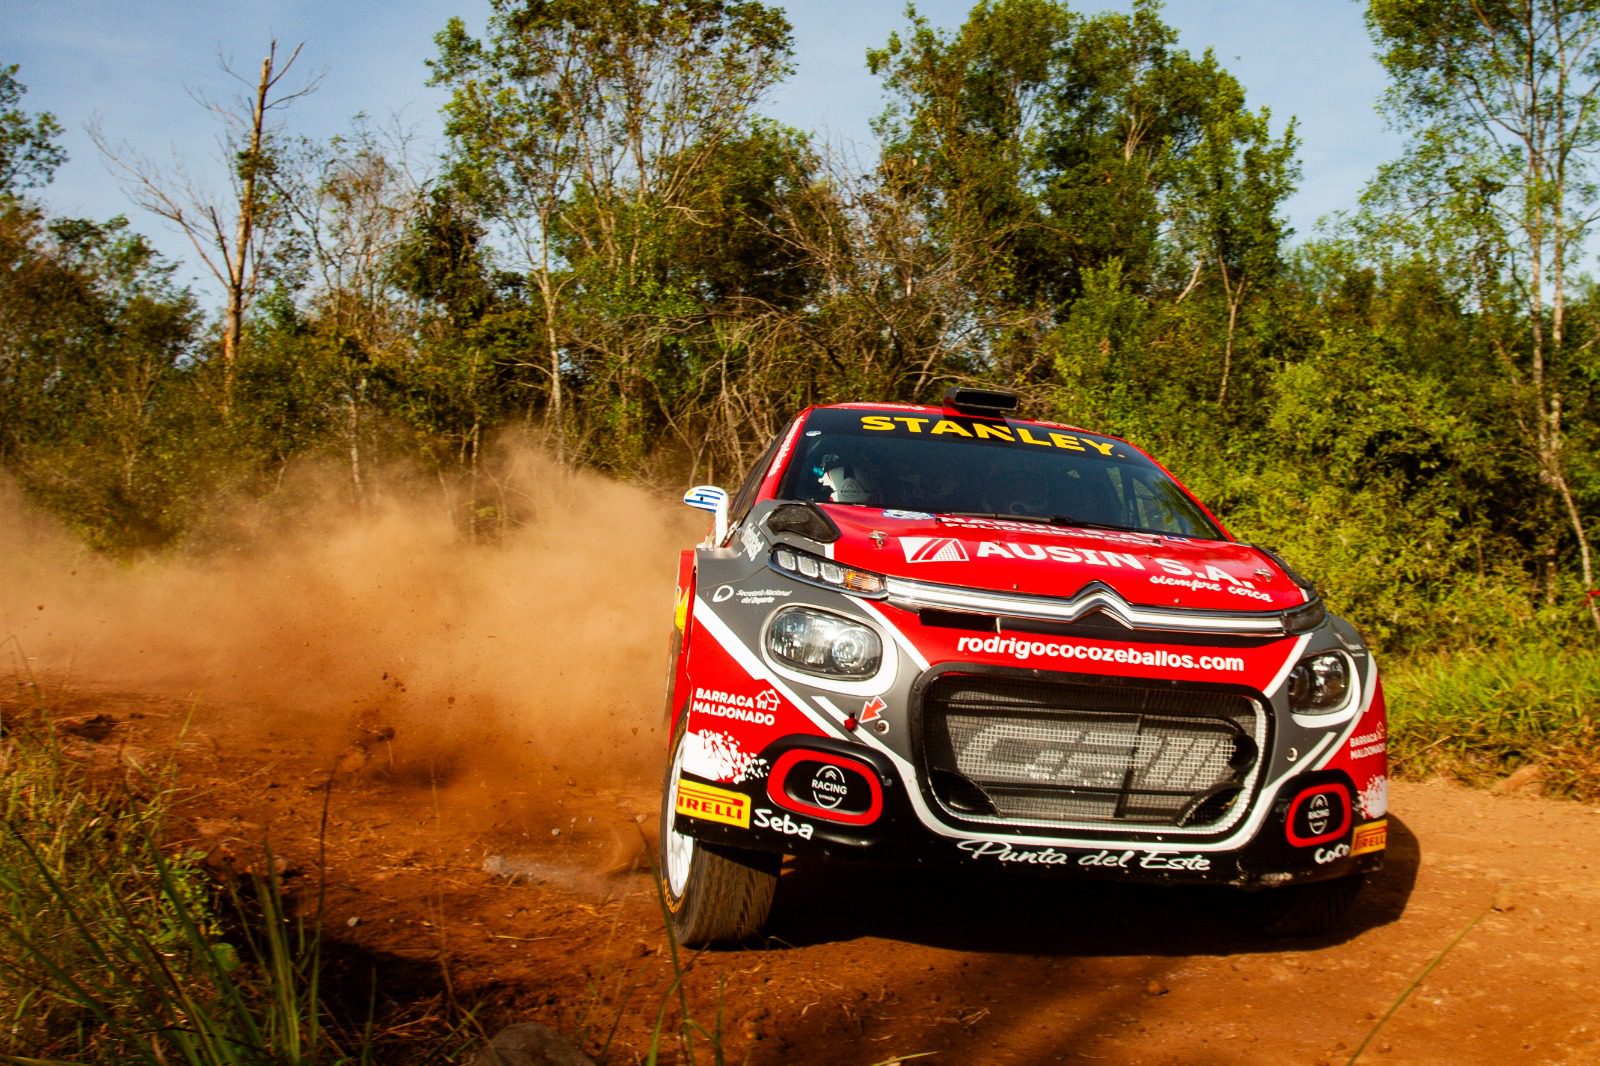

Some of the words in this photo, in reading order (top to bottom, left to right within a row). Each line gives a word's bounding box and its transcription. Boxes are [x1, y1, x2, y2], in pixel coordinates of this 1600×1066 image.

[860, 415, 1117, 456] STANLEY
[976, 541, 1146, 570] AUSIN
[1155, 557, 1254, 589] S.A.
[1149, 575, 1222, 591] siempre
[1227, 585, 1274, 603] cerca
[957, 635, 1245, 672] rodrigococozeballos.com
[695, 687, 755, 709] BARRACA
[692, 701, 776, 727] MALDONADO
[811, 778, 848, 795] RACING
[753, 808, 814, 841] Seba
[956, 838, 1067, 867] Punta
[1077, 849, 1136, 868] del
[1139, 848, 1212, 872] Este
[1314, 842, 1350, 865] Coco
